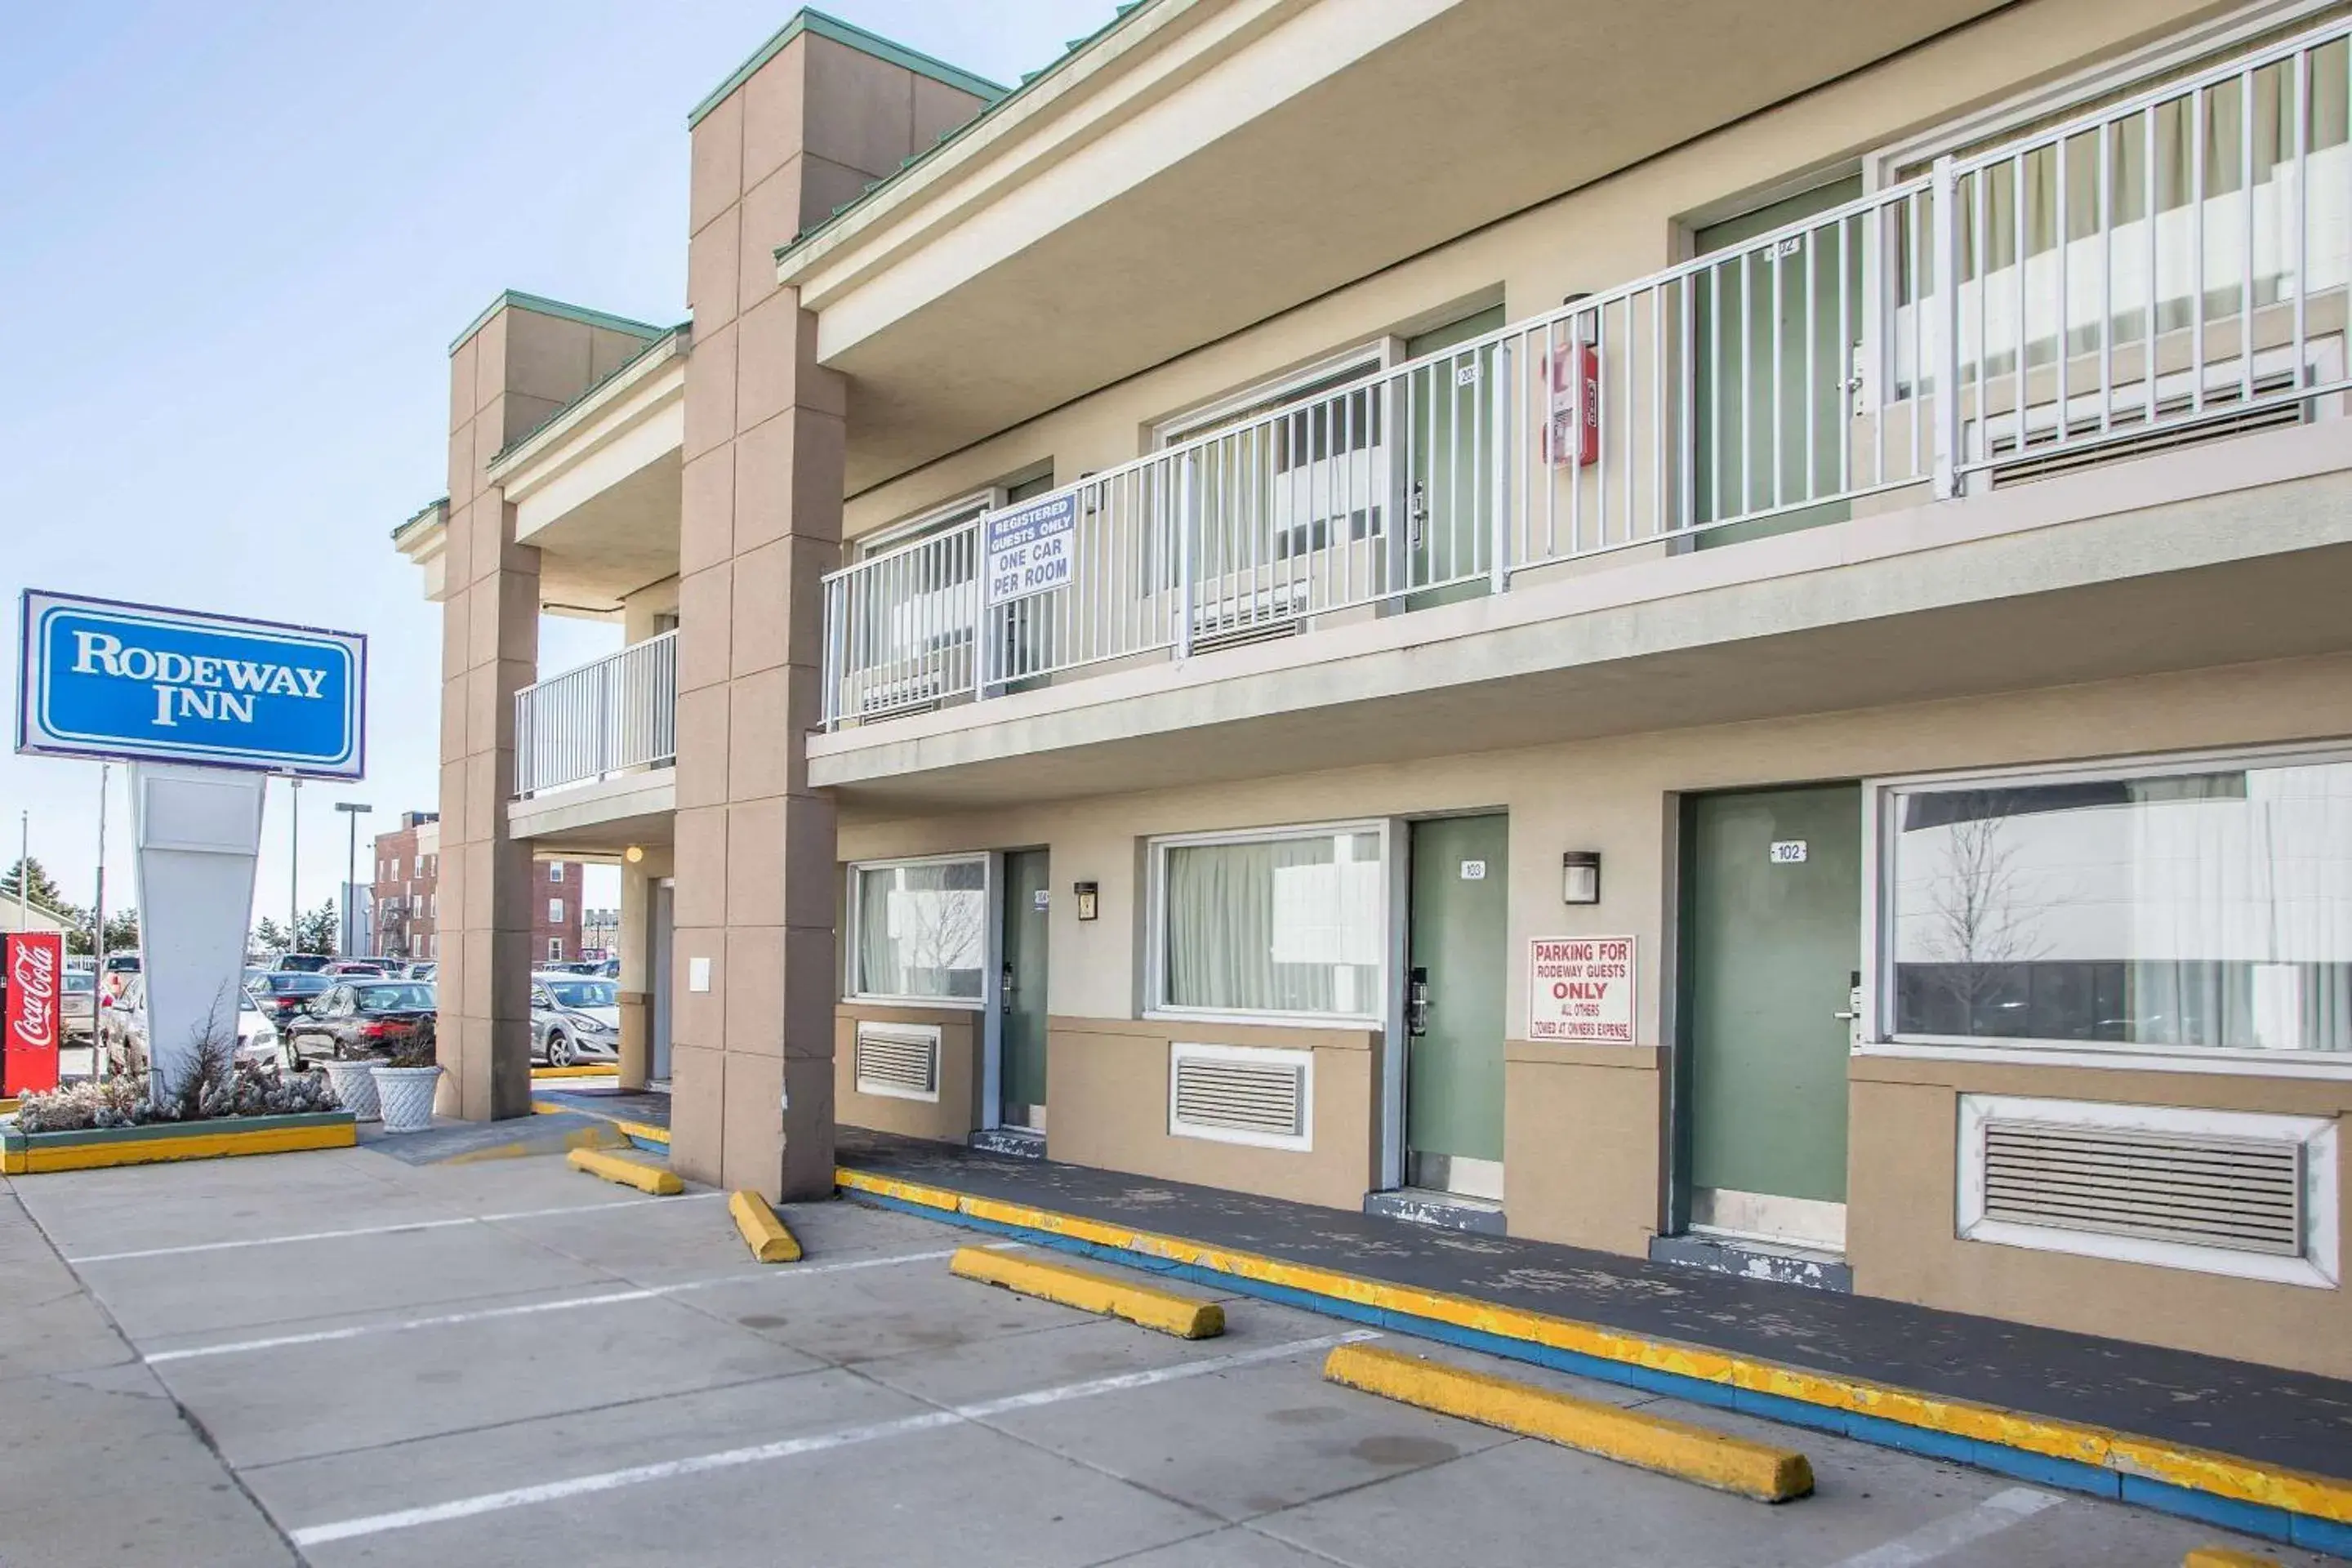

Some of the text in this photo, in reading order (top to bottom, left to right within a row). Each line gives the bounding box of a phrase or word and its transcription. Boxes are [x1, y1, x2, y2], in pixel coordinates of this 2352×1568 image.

[991, 515, 1072, 553] GUESTS ONLY
[995, 501, 1069, 536] REGISTERED
[1000, 538, 1062, 571] ONE CAR
[994, 558, 1067, 596] PER ROOM
[72, 630, 327, 699] RODEWAY
[152, 684, 256, 727] INN
[1779, 844, 1799, 859] 102
[1536, 943, 1627, 961] PARKING FOR
[1537, 964, 1625, 978] RODEWAY GUESTS
[1553, 982, 1608, 1000] ONLY
